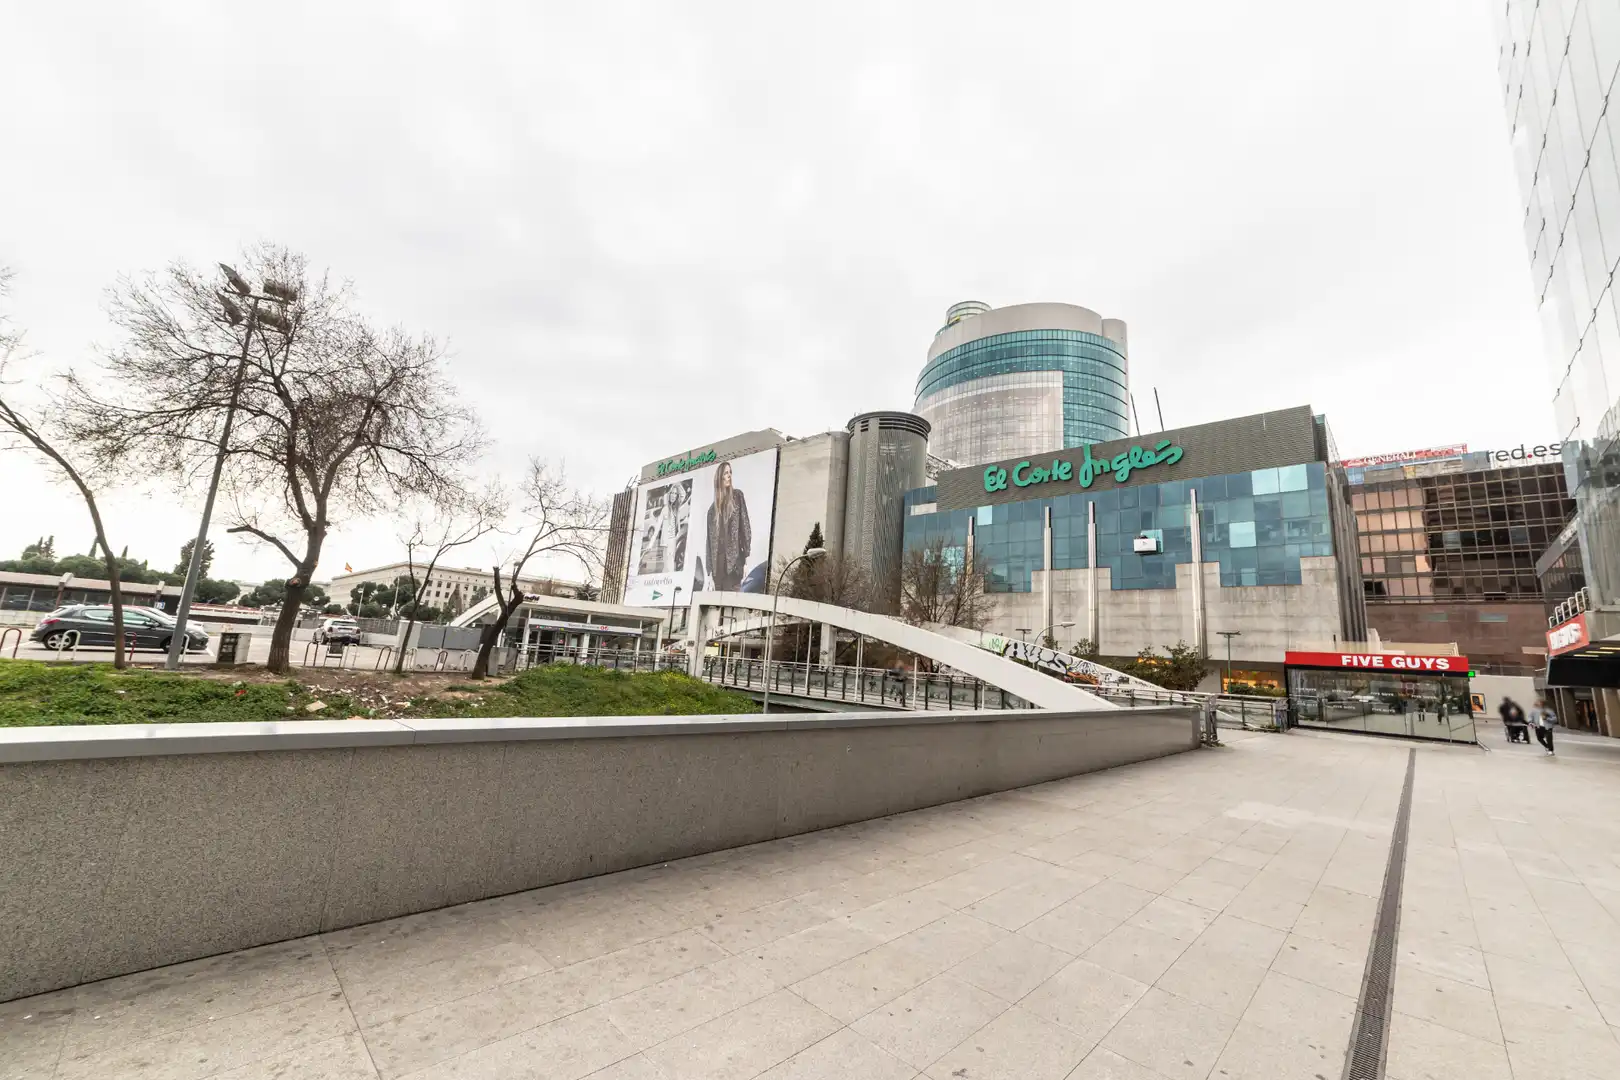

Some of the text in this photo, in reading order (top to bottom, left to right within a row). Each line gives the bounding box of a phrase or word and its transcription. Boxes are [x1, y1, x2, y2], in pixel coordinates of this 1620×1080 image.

[1486, 443, 1562, 463] red.es
[983, 464, 1008, 492] El
[1011, 459, 1073, 487] Corte
[1341, 655, 1450, 670] FIVE GUYS
